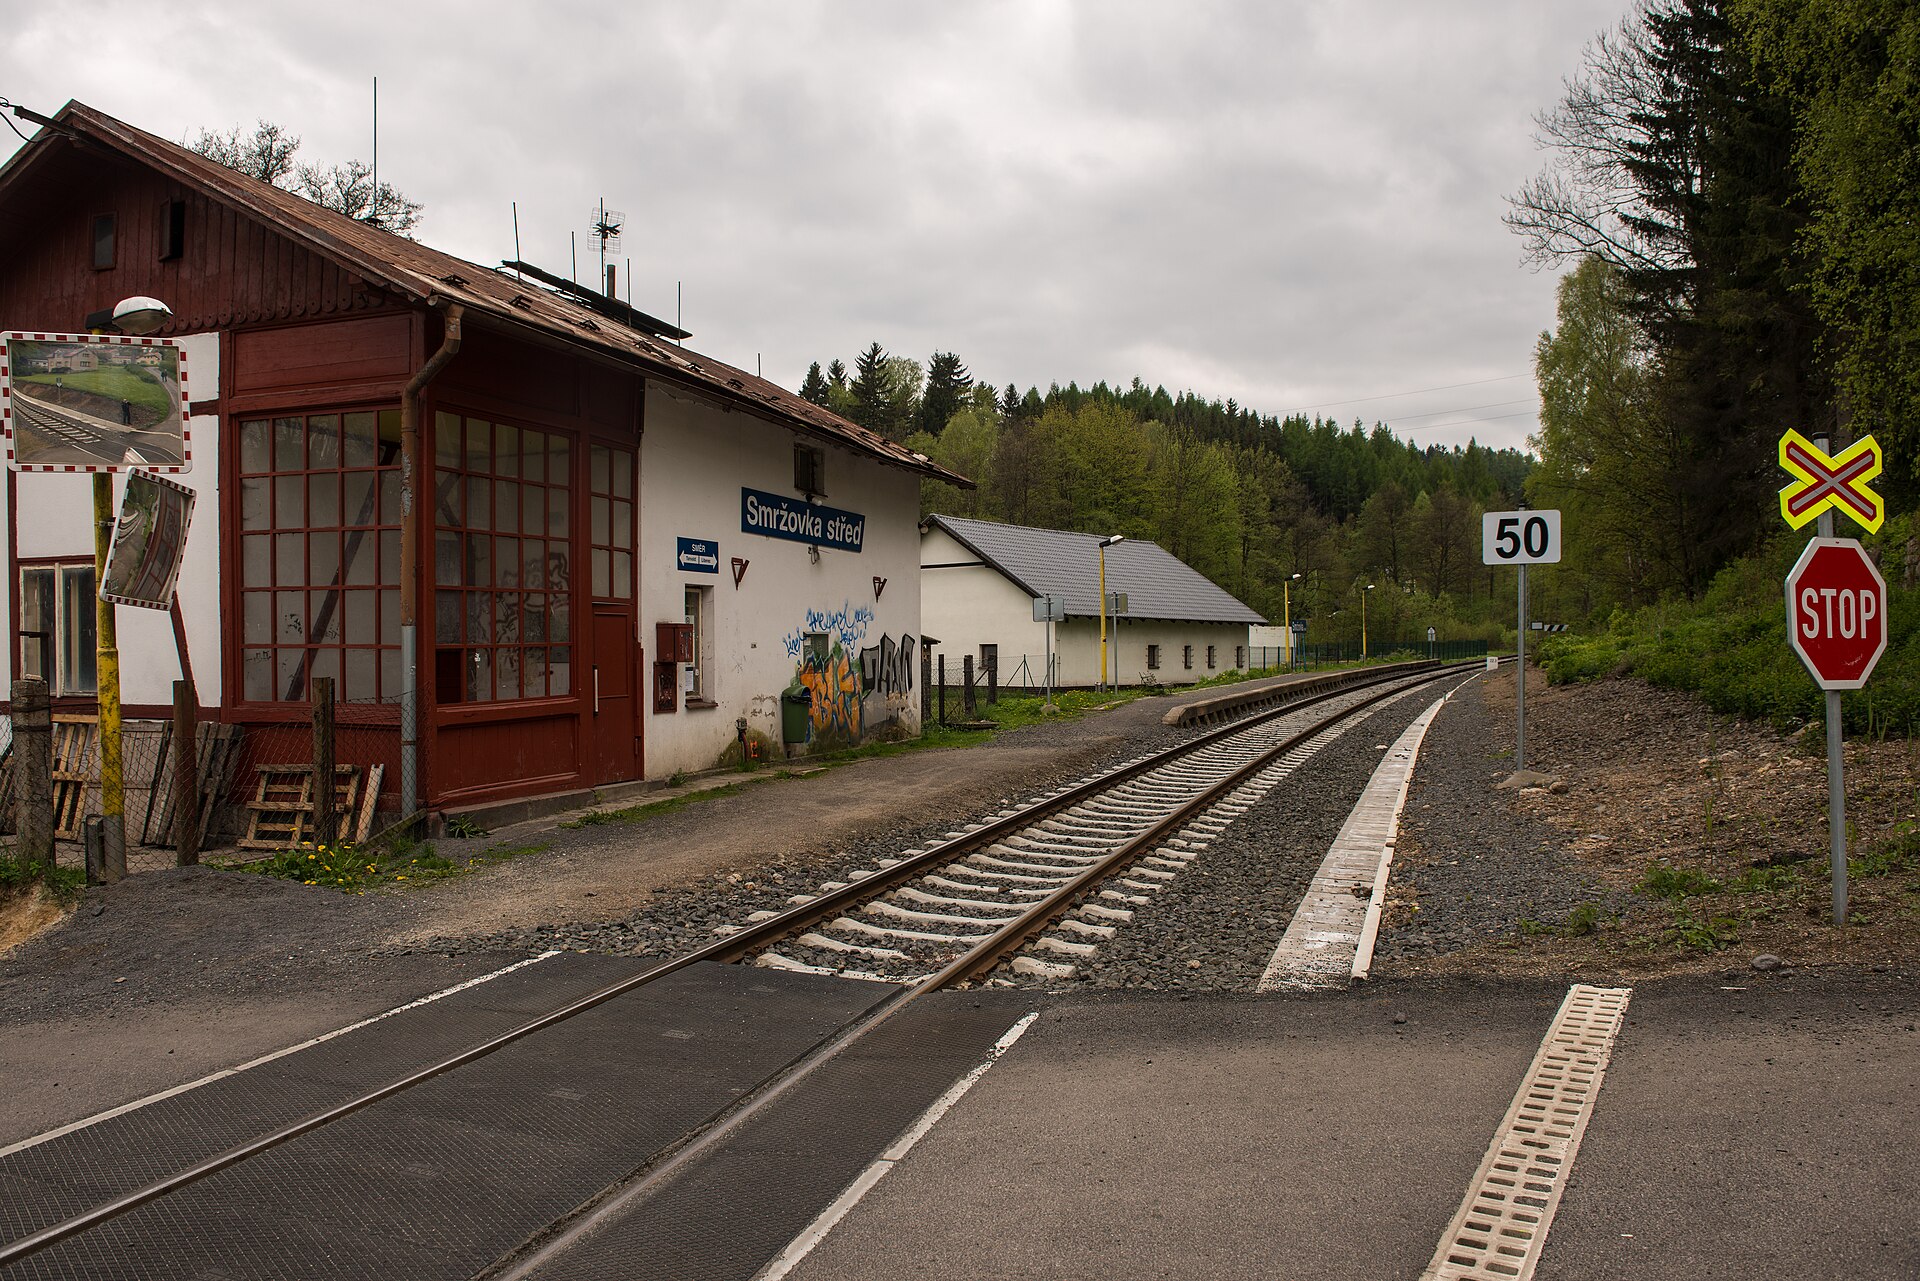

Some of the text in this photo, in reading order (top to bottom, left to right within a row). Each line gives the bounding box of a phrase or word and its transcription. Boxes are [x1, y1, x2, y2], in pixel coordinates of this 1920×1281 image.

[746, 495, 862, 545] Smržovka střed
[1495, 516, 1549, 559] 50
[1801, 587, 1876, 639] STOP
